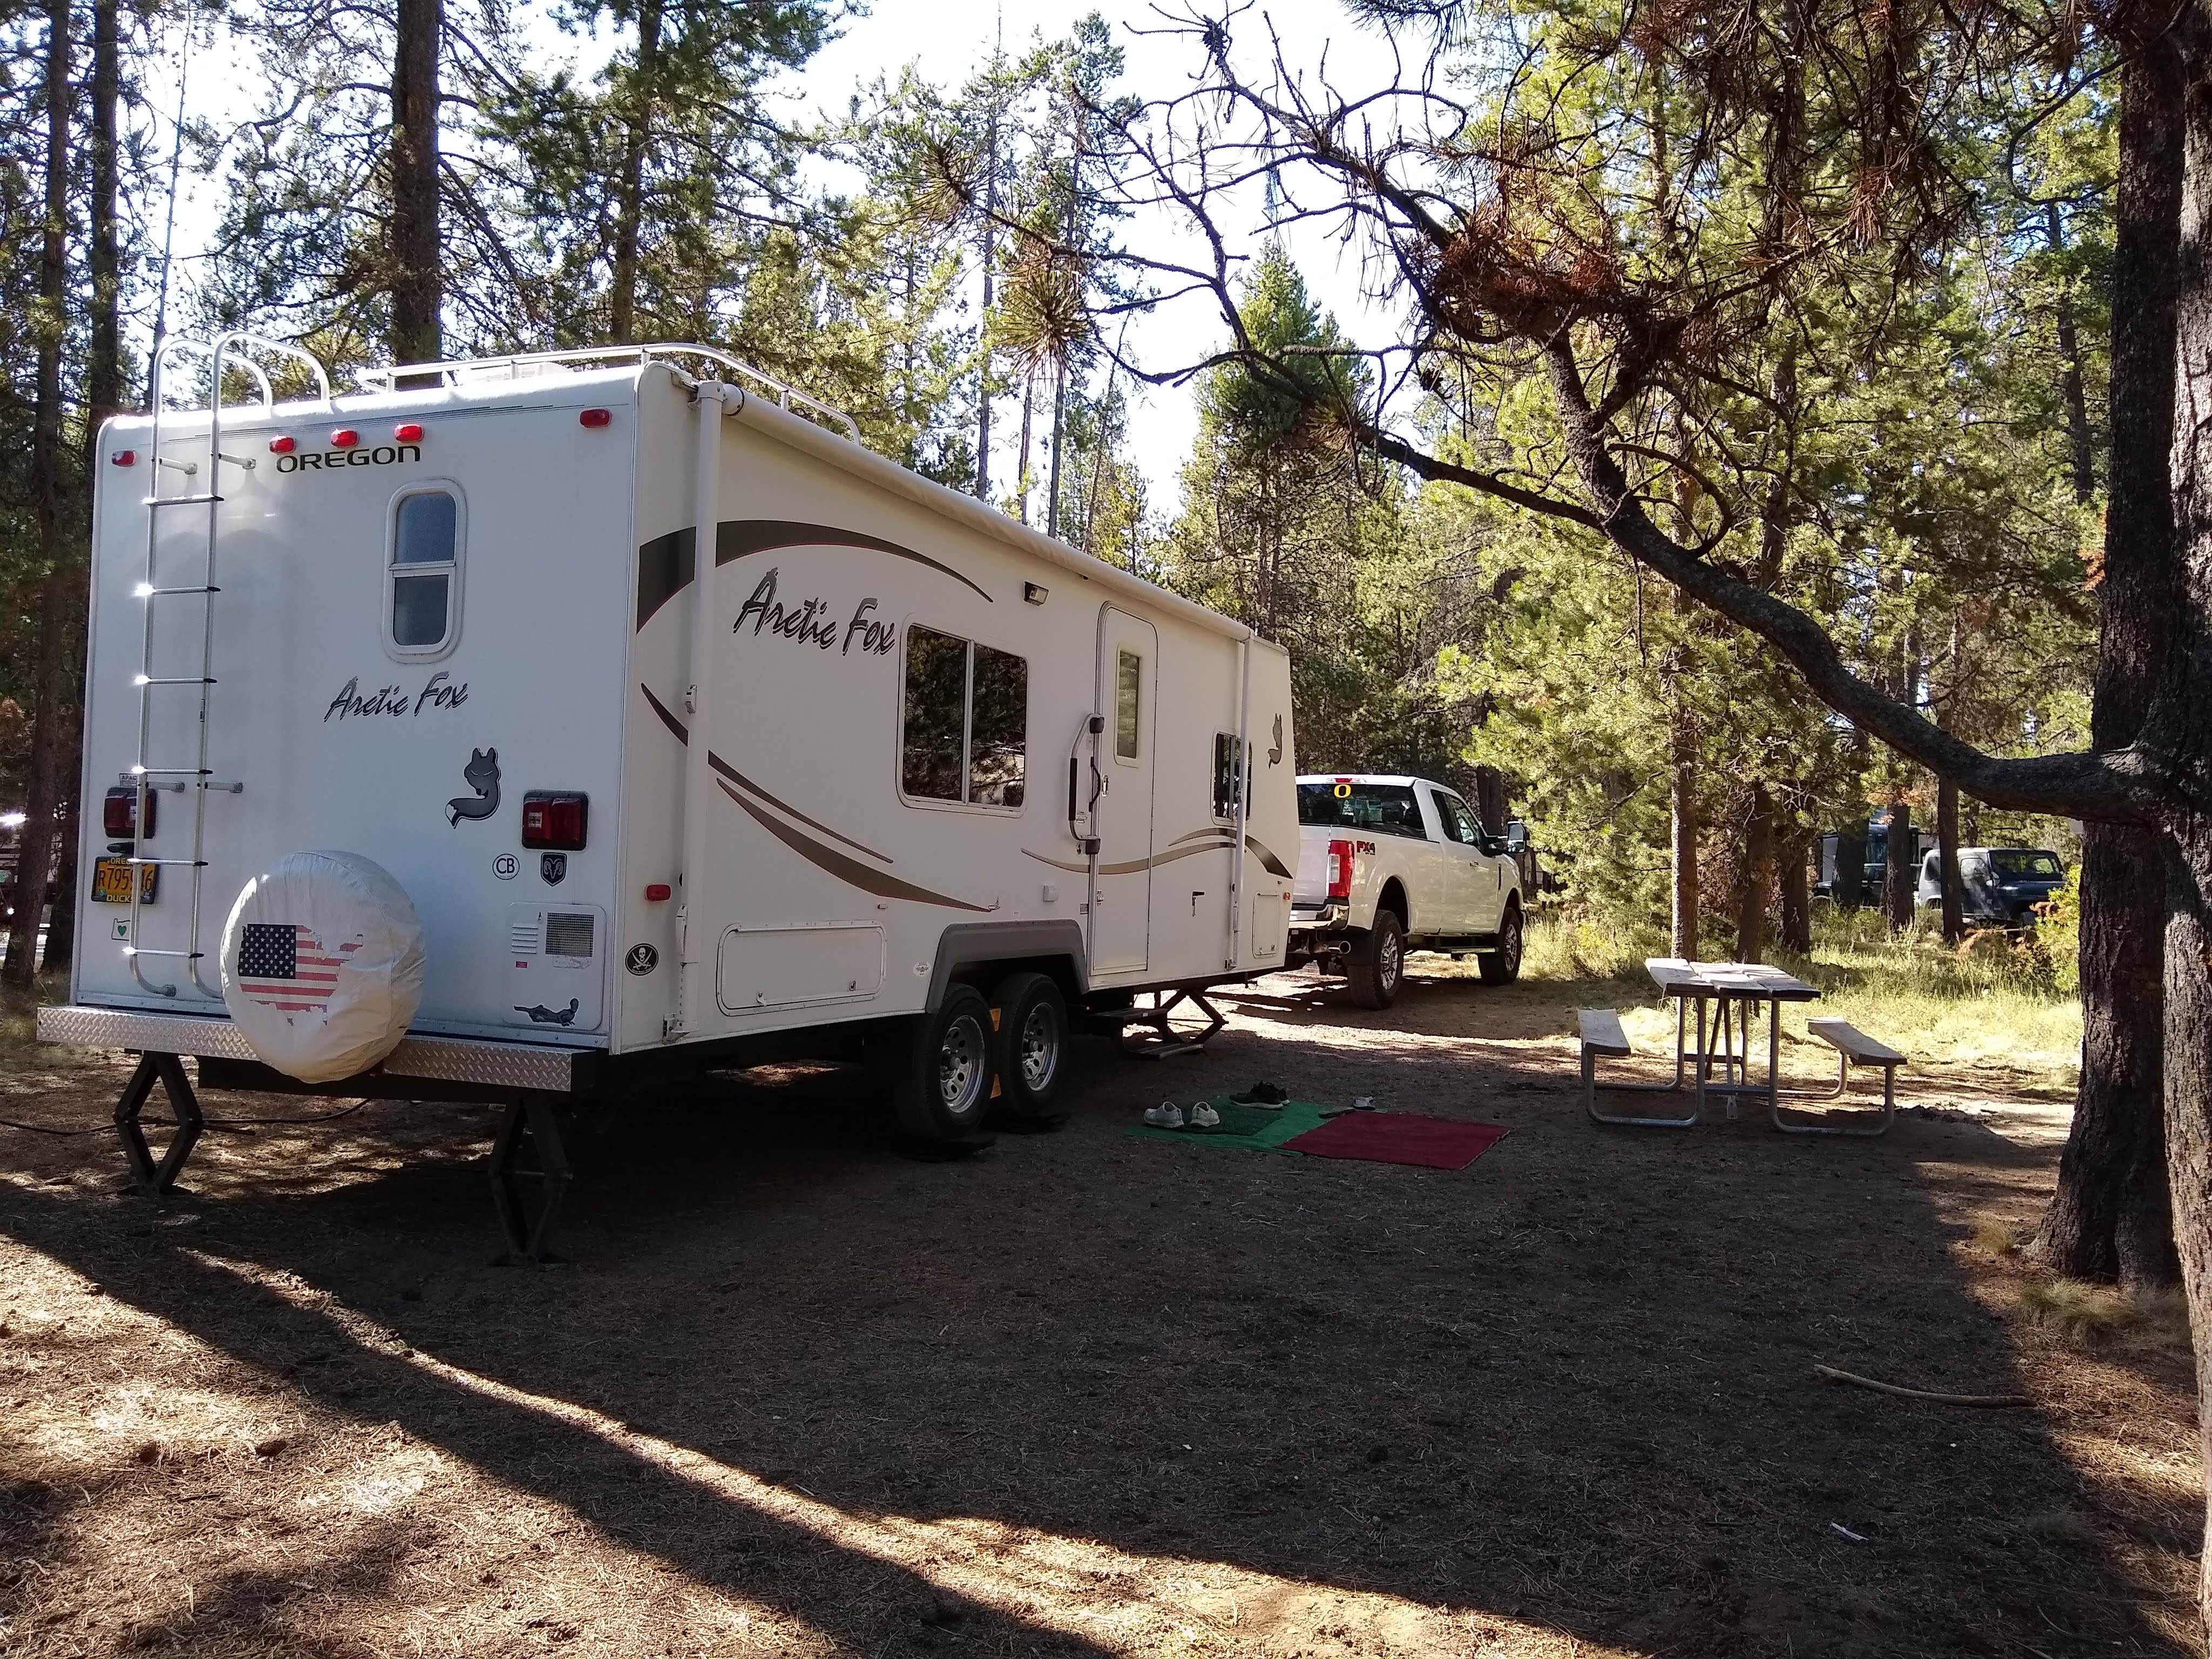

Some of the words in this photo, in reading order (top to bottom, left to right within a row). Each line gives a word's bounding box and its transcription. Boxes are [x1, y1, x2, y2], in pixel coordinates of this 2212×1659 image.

[276, 445, 421, 473] OREGON
[733, 567, 837, 650] Arctic
[842, 597, 895, 657] Fox
[323, 676, 409, 723] Arctic
[414, 671, 468, 717] Fox
[1334, 784, 1351, 798] O
[1356, 840, 1375, 853] FX4
[496, 858, 515, 874] CB
[106, 894, 132, 902] DUCK
